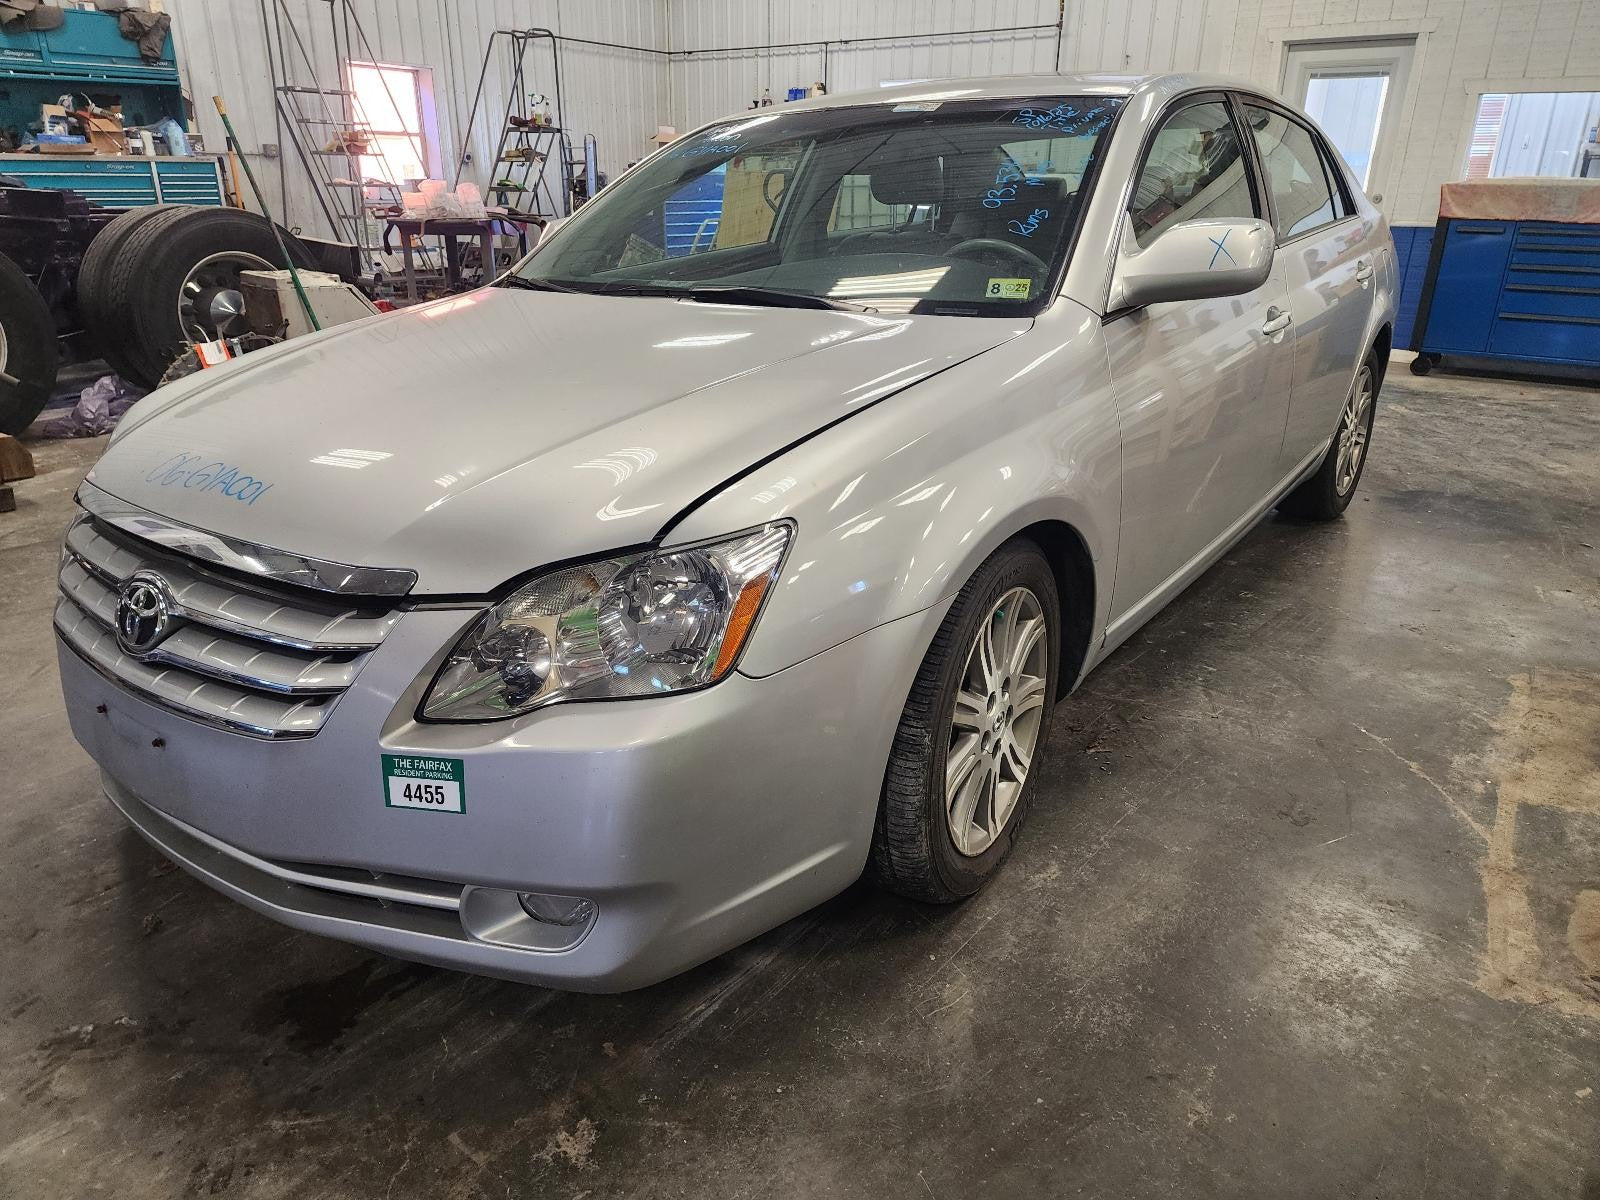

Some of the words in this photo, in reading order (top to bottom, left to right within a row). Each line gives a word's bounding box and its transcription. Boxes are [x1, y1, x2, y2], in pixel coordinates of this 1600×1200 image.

[1007, 208, 1049, 238] Runs
[990, 283, 1001, 295] 8
[1014, 283, 1028, 292] 25
[393, 758, 413, 769] THE
[414, 760, 453, 772] FAIRFAX
[394, 768, 424, 777] RESIDENT
[425, 771, 454, 780] PARKING
[403, 783, 446, 805] 4455
